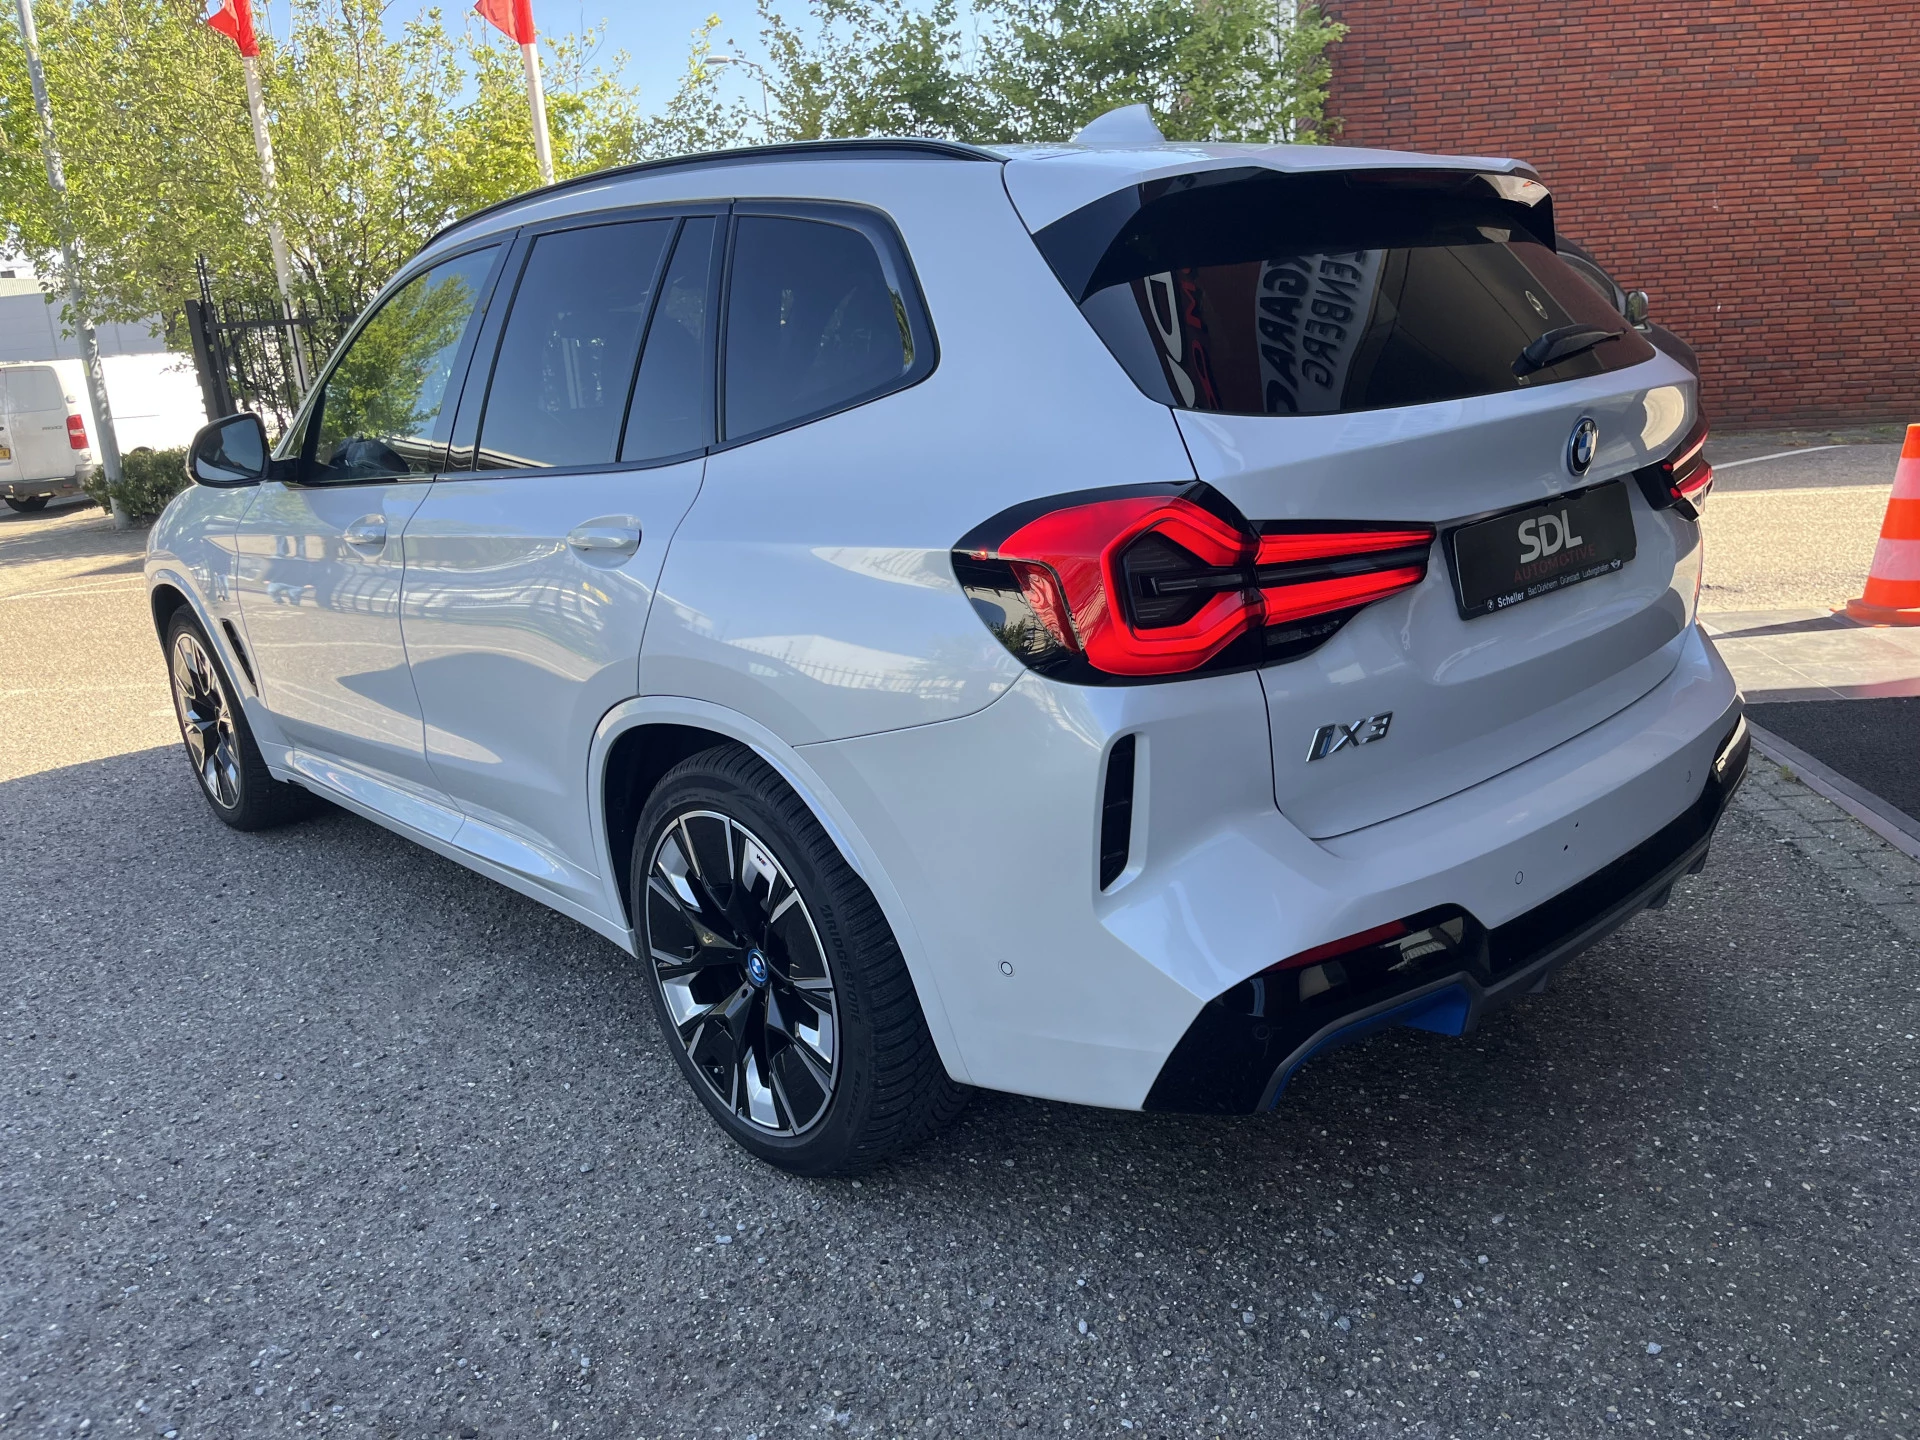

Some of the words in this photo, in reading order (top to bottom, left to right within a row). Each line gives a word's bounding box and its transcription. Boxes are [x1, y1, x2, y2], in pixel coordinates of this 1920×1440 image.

[1518, 509, 1583, 564] SDL
[1514, 544, 1596, 583] AUTOMOTIVE
[1497, 591, 1525, 608] Scheller
[1527, 585, 1537, 596] Bad
[819, 904, 862, 1025] BRIDGESTONE
